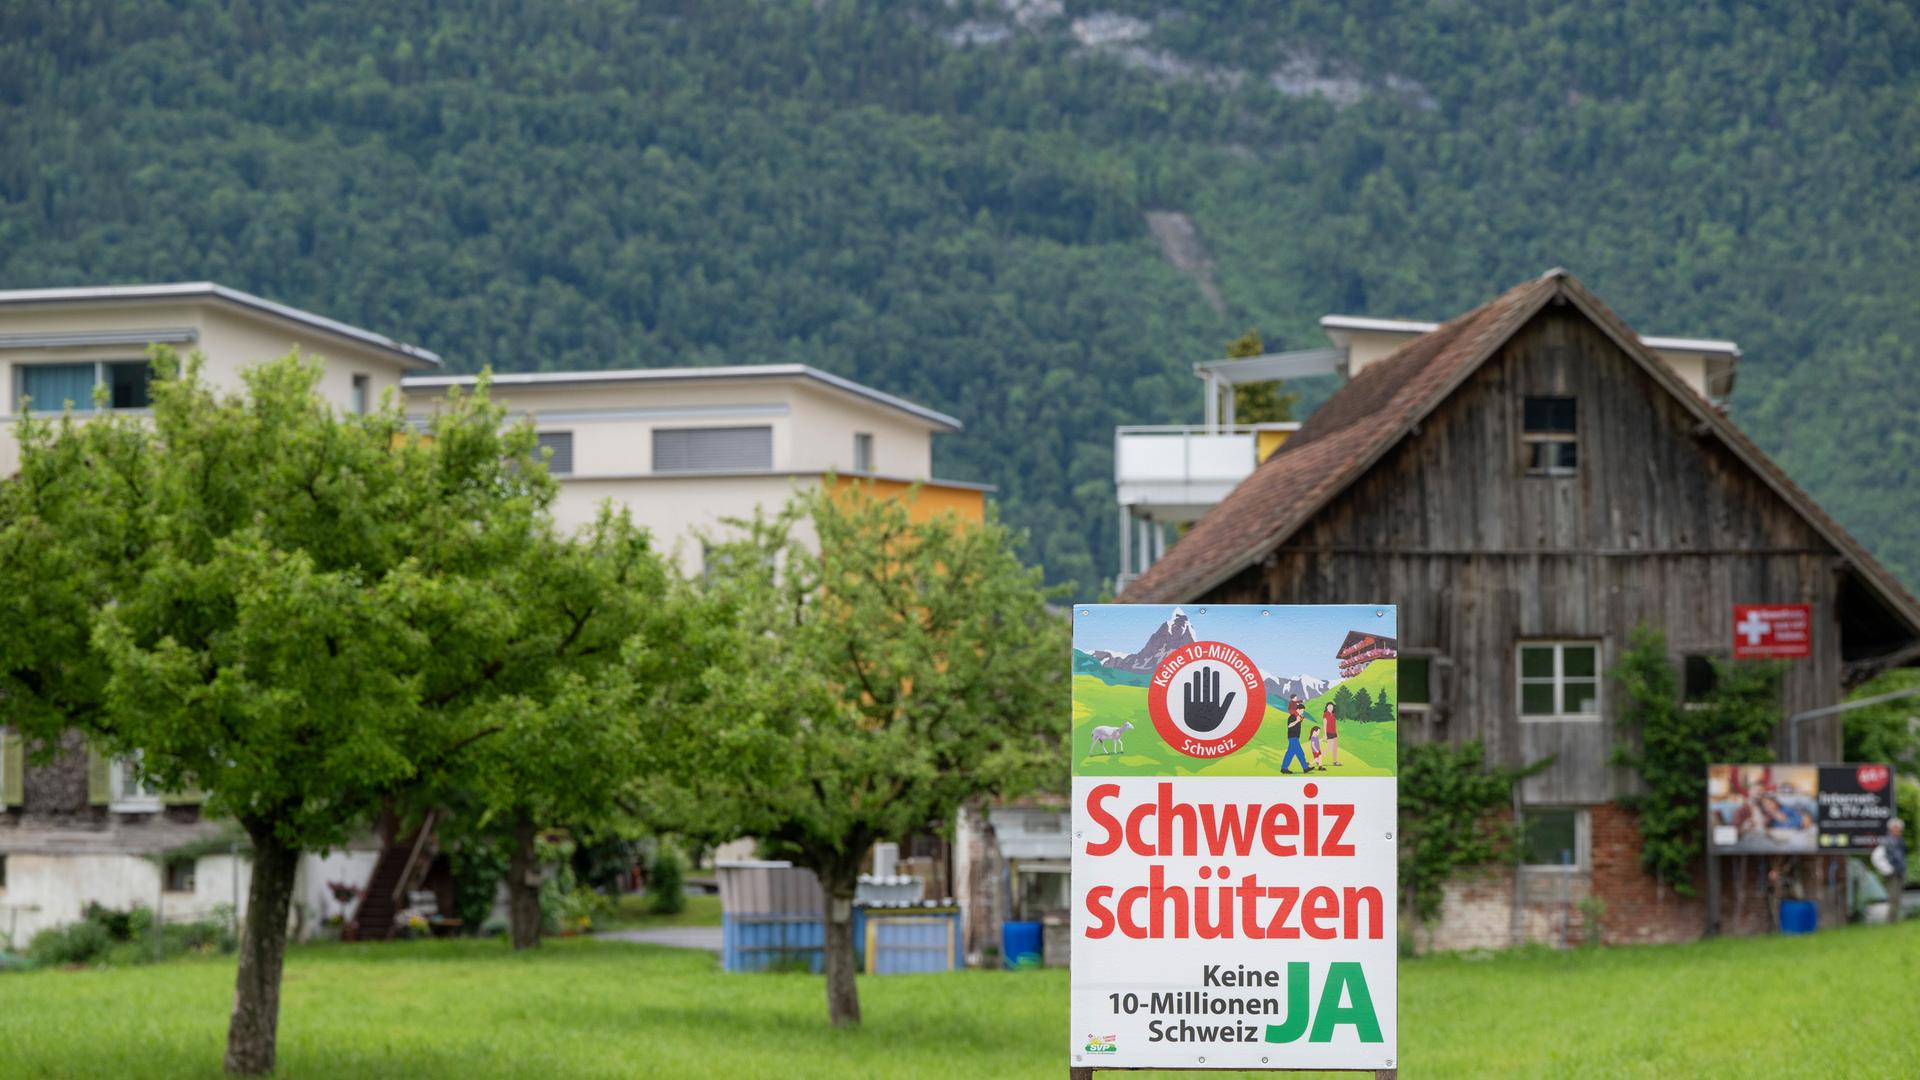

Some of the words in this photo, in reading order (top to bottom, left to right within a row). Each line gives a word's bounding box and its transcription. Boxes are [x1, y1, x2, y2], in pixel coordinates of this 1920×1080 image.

[1153, 654, 1186, 688] Keine
[1186, 643, 1258, 689] 10-Millionen
[1181, 737, 1237, 757] Schweiz
[1085, 782, 1356, 857] Schweiz
[1084, 865, 1384, 940] schützen
[1203, 964, 1280, 987] Keine
[1108, 992, 1279, 1015] 10-Millionen
[1265, 961, 1385, 1044] JA
[1148, 1020, 1258, 1043] Schweiz
